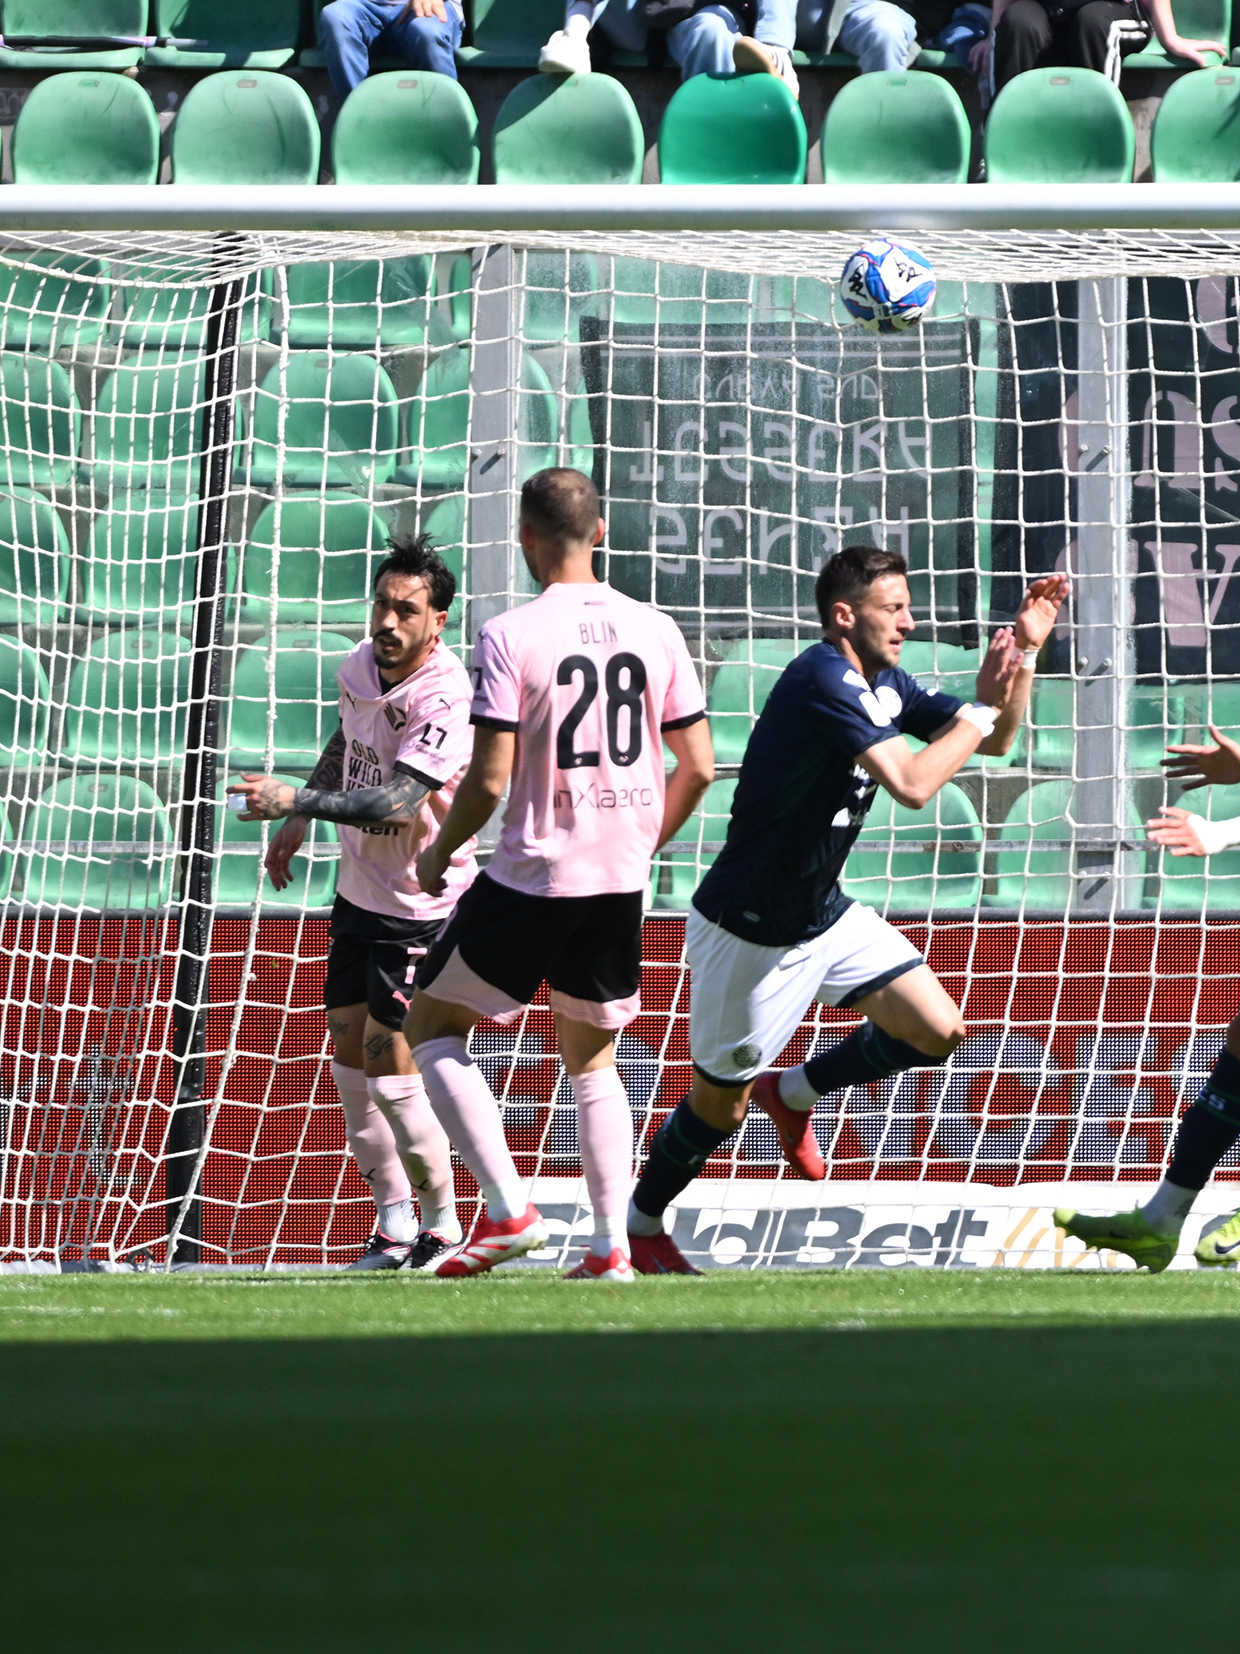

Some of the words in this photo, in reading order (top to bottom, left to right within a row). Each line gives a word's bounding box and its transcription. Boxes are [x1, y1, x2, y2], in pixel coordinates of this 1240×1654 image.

[579, 621, 618, 645] BLIN
[557, 651, 647, 769] 28
[352, 739, 379, 766] OLD
[348, 756, 383, 787] WILD
[532, 1203, 989, 1268] GldBet
